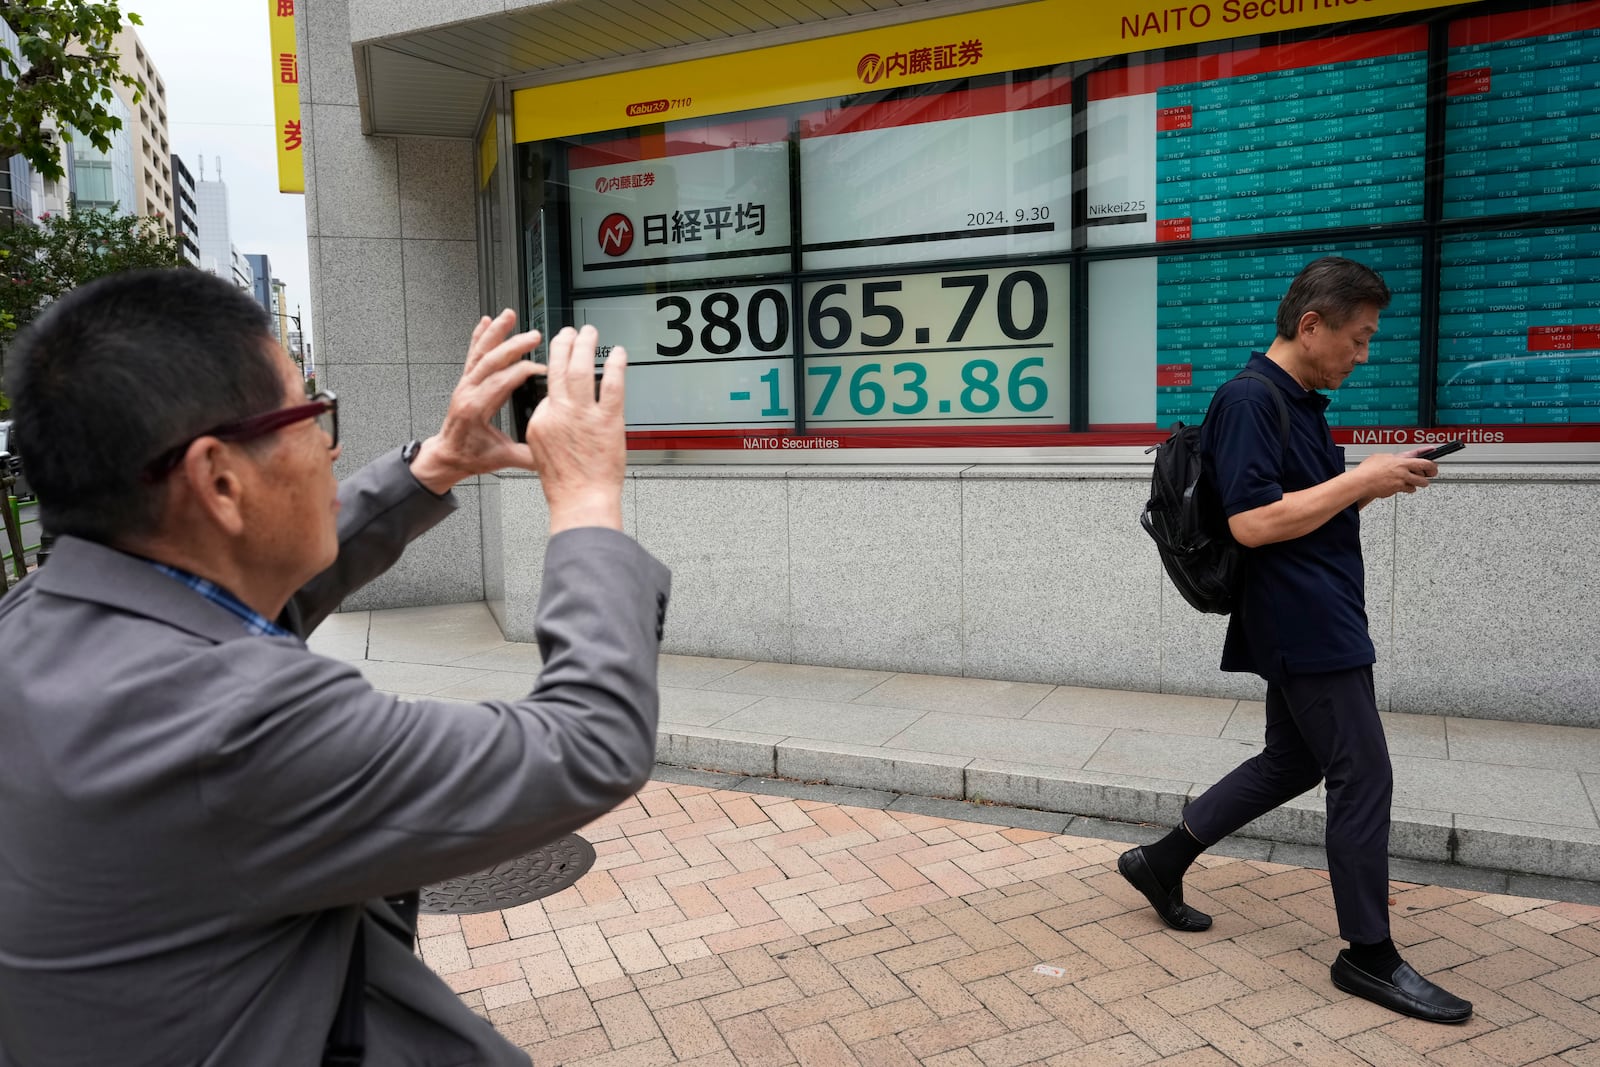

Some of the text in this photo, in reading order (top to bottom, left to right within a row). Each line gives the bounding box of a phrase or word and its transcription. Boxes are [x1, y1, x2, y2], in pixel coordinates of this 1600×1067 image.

[1121, 4, 1211, 39] NAITO
[887, 39, 983, 78] 内藤証券
[630, 98, 692, 115] Kabuスタ 7110
[1164, 108, 1185, 116] DeNA
[609, 173, 655, 191] 内藤証券
[1015, 206, 1050, 222] 9.30
[1089, 200, 1146, 216] Nikkei225
[644, 203, 766, 246] 日経平均
[743, 437, 840, 449] NAITO Securities
[1352, 429, 1505, 443] NAITO Securities
